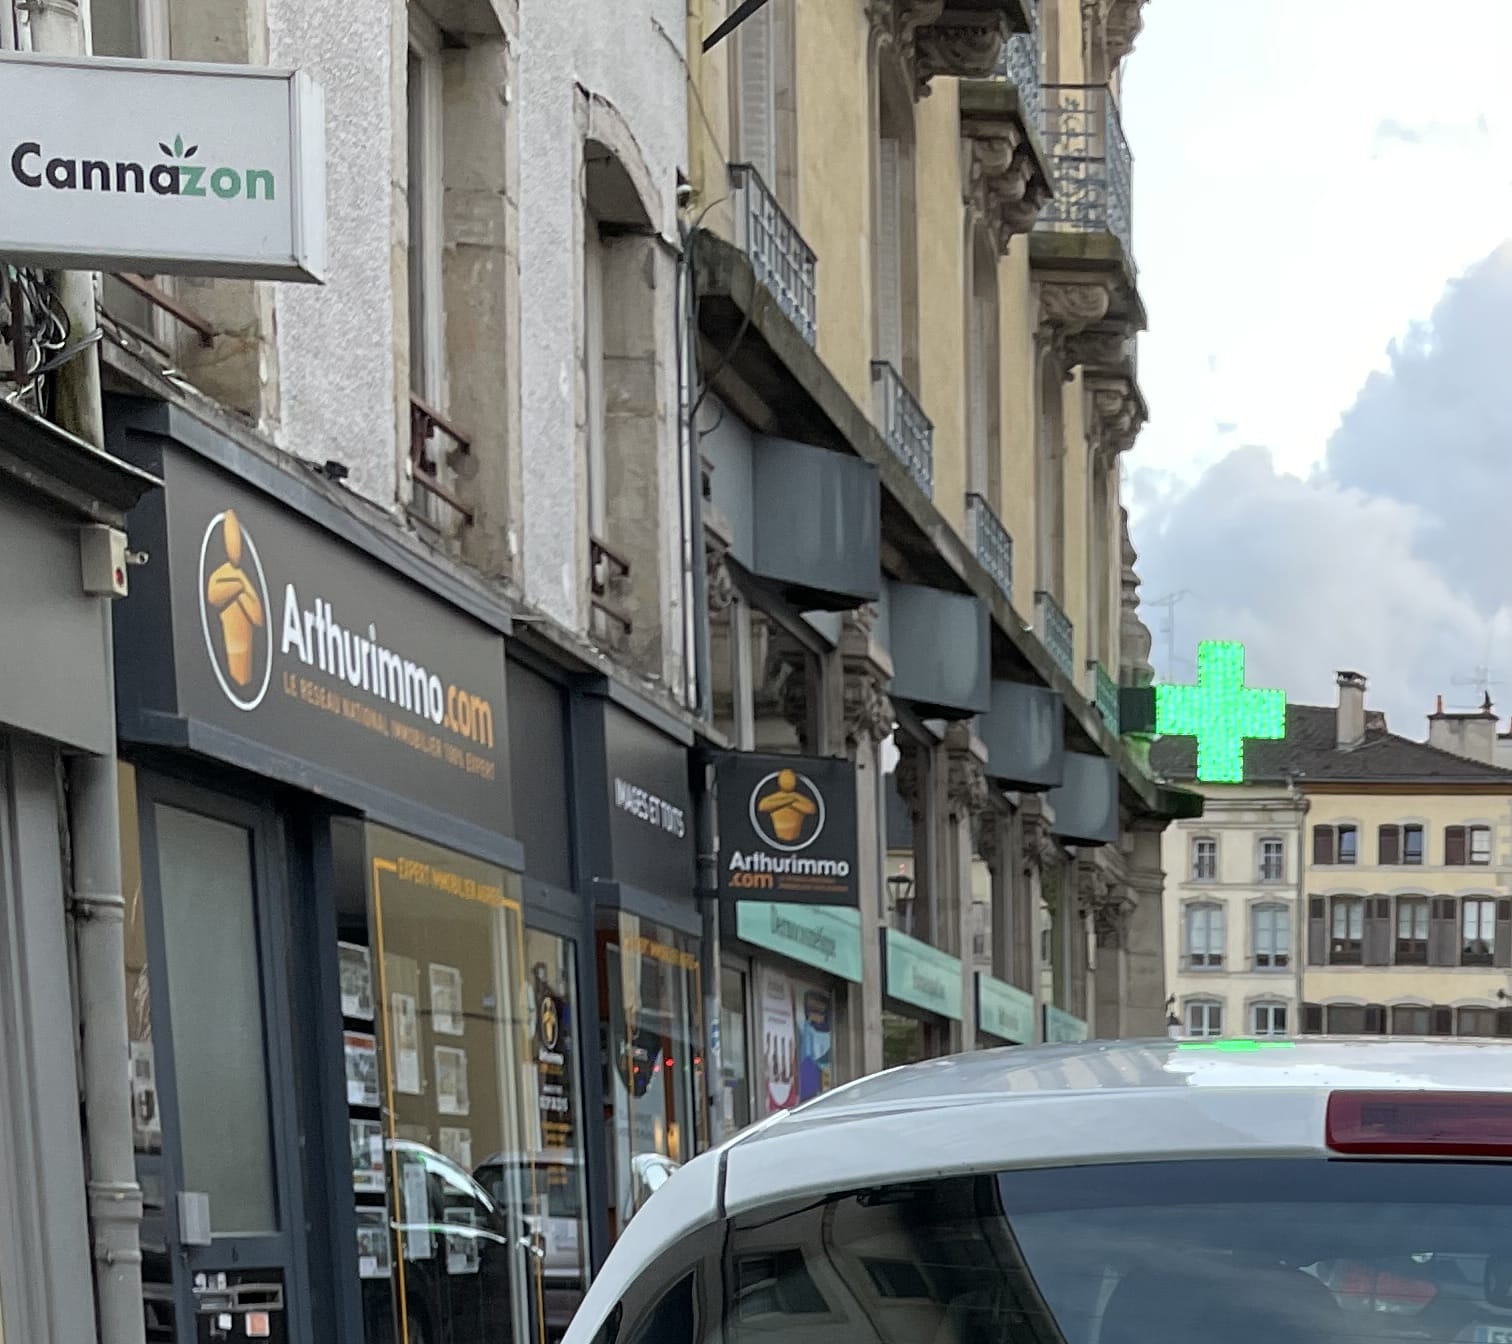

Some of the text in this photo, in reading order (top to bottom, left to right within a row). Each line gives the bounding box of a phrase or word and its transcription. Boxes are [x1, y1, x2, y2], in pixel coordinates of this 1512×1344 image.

[11, 142, 275, 200] Cannazon
[729, 850, 850, 877] Arthurimmo
[728, 872, 774, 890] .com
